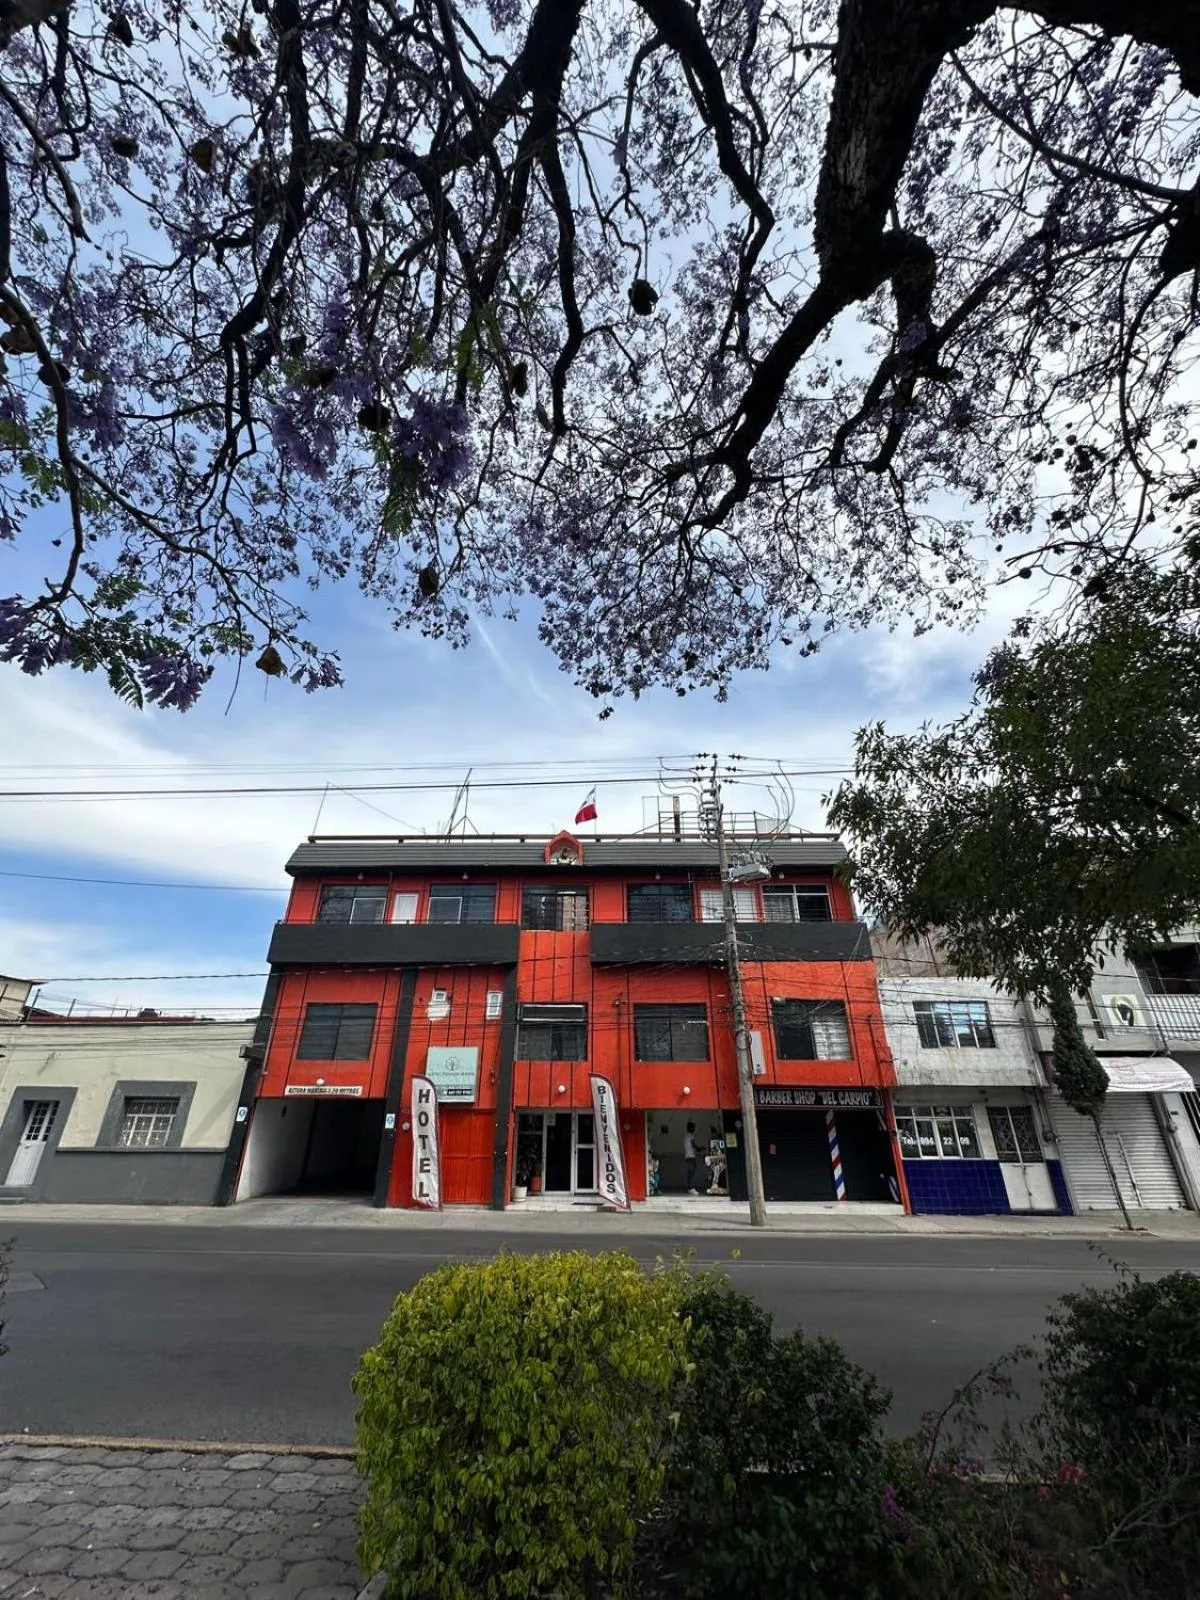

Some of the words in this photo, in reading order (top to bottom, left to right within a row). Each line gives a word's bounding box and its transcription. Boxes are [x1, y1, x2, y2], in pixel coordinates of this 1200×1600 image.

[418, 1089, 430, 1198] HOTEL
[597, 1085, 616, 1194] BIENVENIDOS
[759, 1090, 793, 1104] BARBER
[794, 1090, 816, 1104] SHOP
